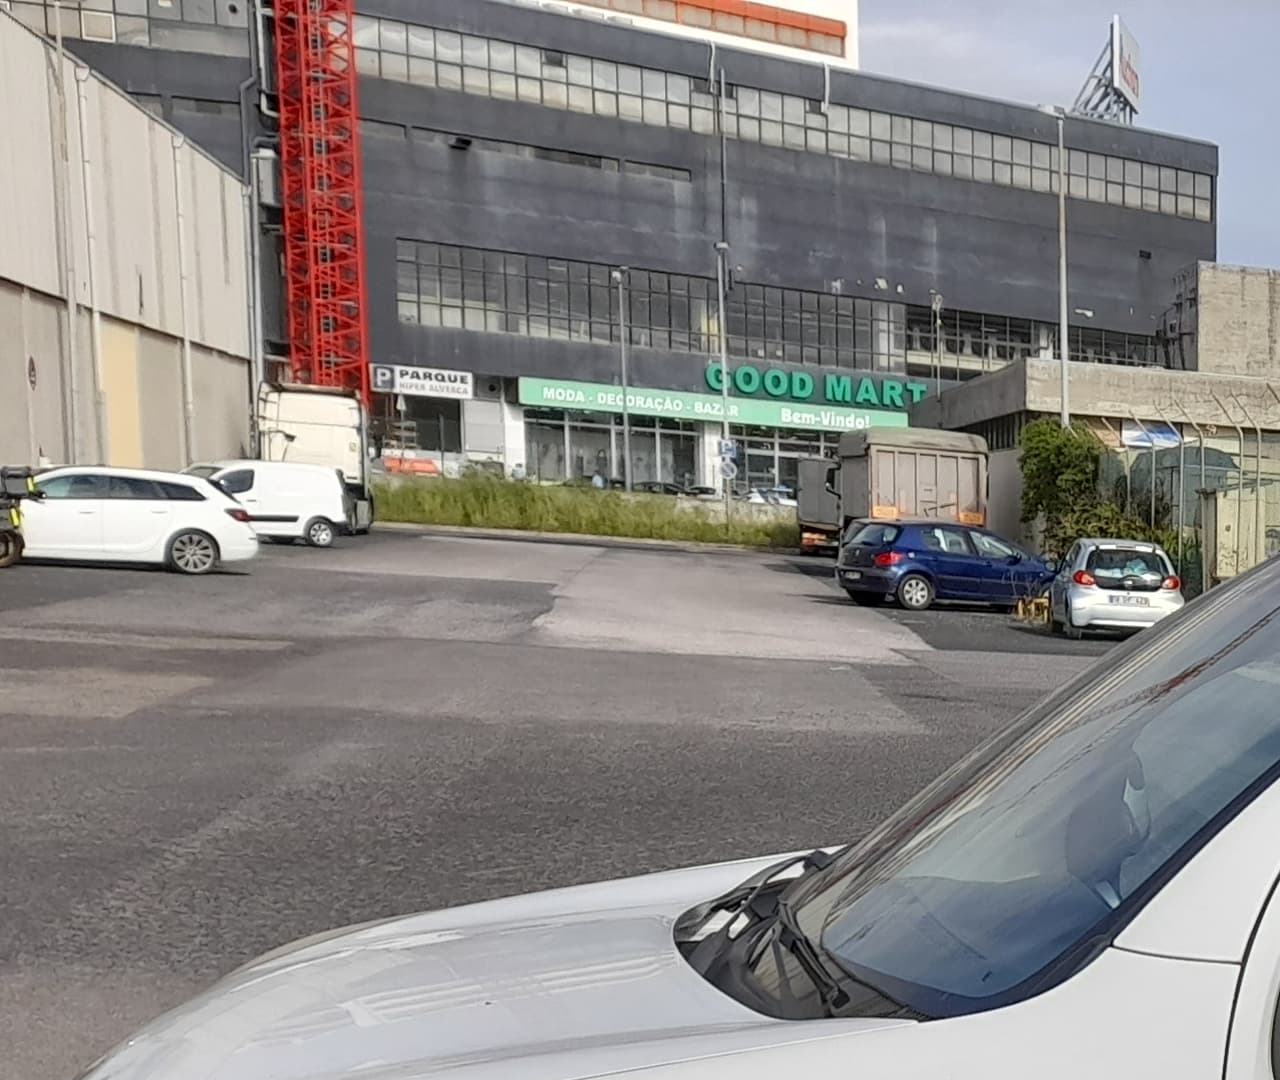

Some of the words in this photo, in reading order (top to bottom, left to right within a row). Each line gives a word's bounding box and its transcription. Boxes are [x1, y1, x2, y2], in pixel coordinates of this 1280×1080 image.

[375, 368, 392, 387] P
[399, 369, 469, 385] PARQUE
[705, 362, 815, 399] GOOD
[825, 373, 928, 407] MART
[543, 386, 585, 402] MODA
[597, 391, 683, 413] DECORAÇÃO
[781, 407, 872, 428] Bem-Vindo!
